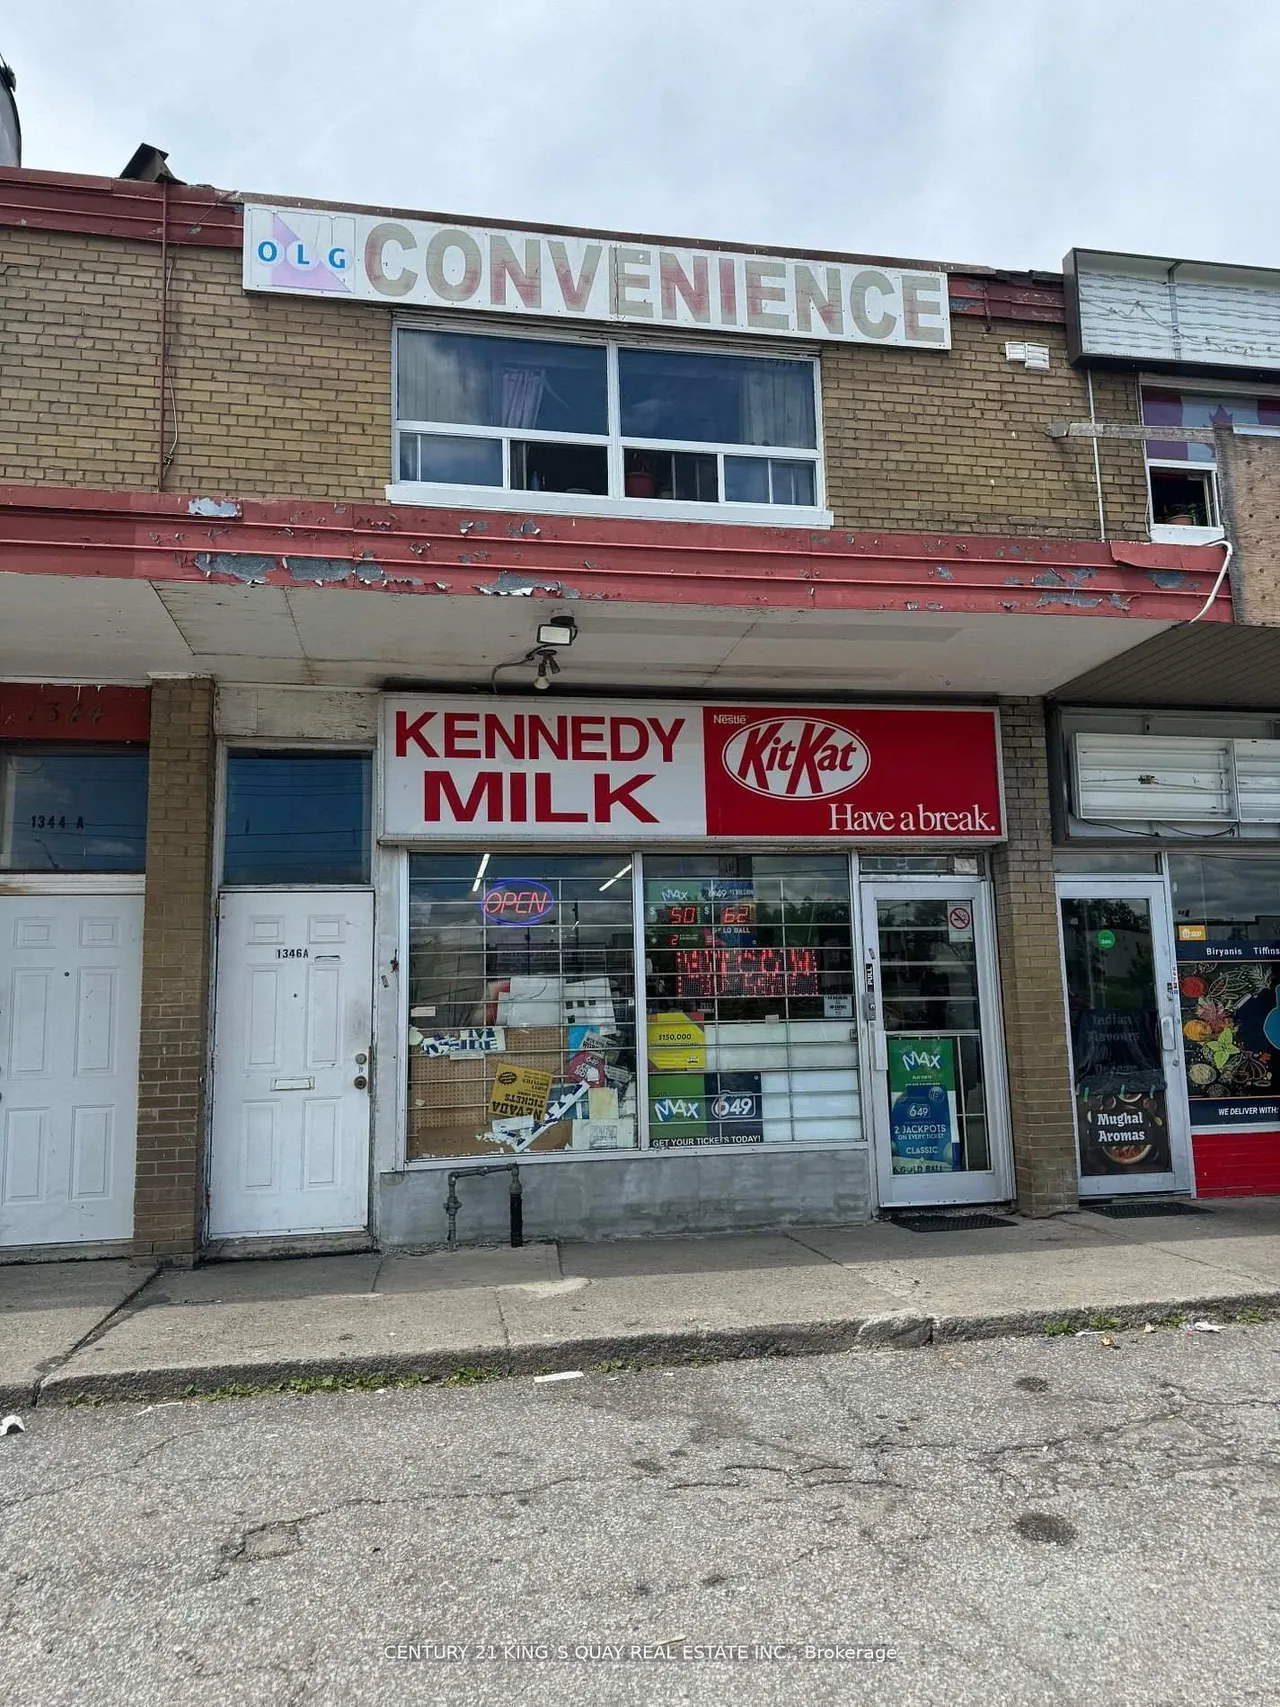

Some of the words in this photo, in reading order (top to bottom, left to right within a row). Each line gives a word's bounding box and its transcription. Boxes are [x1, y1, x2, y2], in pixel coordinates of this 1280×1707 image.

[364, 222, 946, 344] CONVENIENCE
[395, 710, 686, 762] KENNEDY
[424, 770, 660, 823] MILK
[31, 815, 66, 829] 1344
[76, 816, 84, 829] A
[828, 803, 895, 831] Have
[900, 808, 915, 831] a
[917, 804, 996, 832] break.
[484, 891, 548, 914] OPEN
[661, 889, 689, 902] MAX
[671, 907, 696, 924] 50
[724, 906, 749, 924] 62
[277, 948, 309, 959] 1346A
[1206, 947, 1242, 957] Biryanis
[866, 967, 874, 986] PULL
[658, 1033, 692, 1042] $150,000
[902, 1050, 941, 1072] MAX
[504, 1093, 544, 1109] TICKETS
[654, 1099, 700, 1122] MAX
[1218, 1108, 1229, 1116] WE
[1230, 1107, 1258, 1115] DELIVER
[1259, 1106, 1279, 1114] WITH:
[1097, 1111, 1143, 1128] Mughal
[894, 1126, 900, 1135] 2
[902, 1124, 947, 1134] JACKPOTS
[1098, 1130, 1145, 1142] Aromas
[653, 1139, 669, 1148] GET
[671, 1137, 695, 1147] YOUR
[731, 1135, 761, 1144] TODAY!
[905, 1146, 938, 1155] CLASSIC
